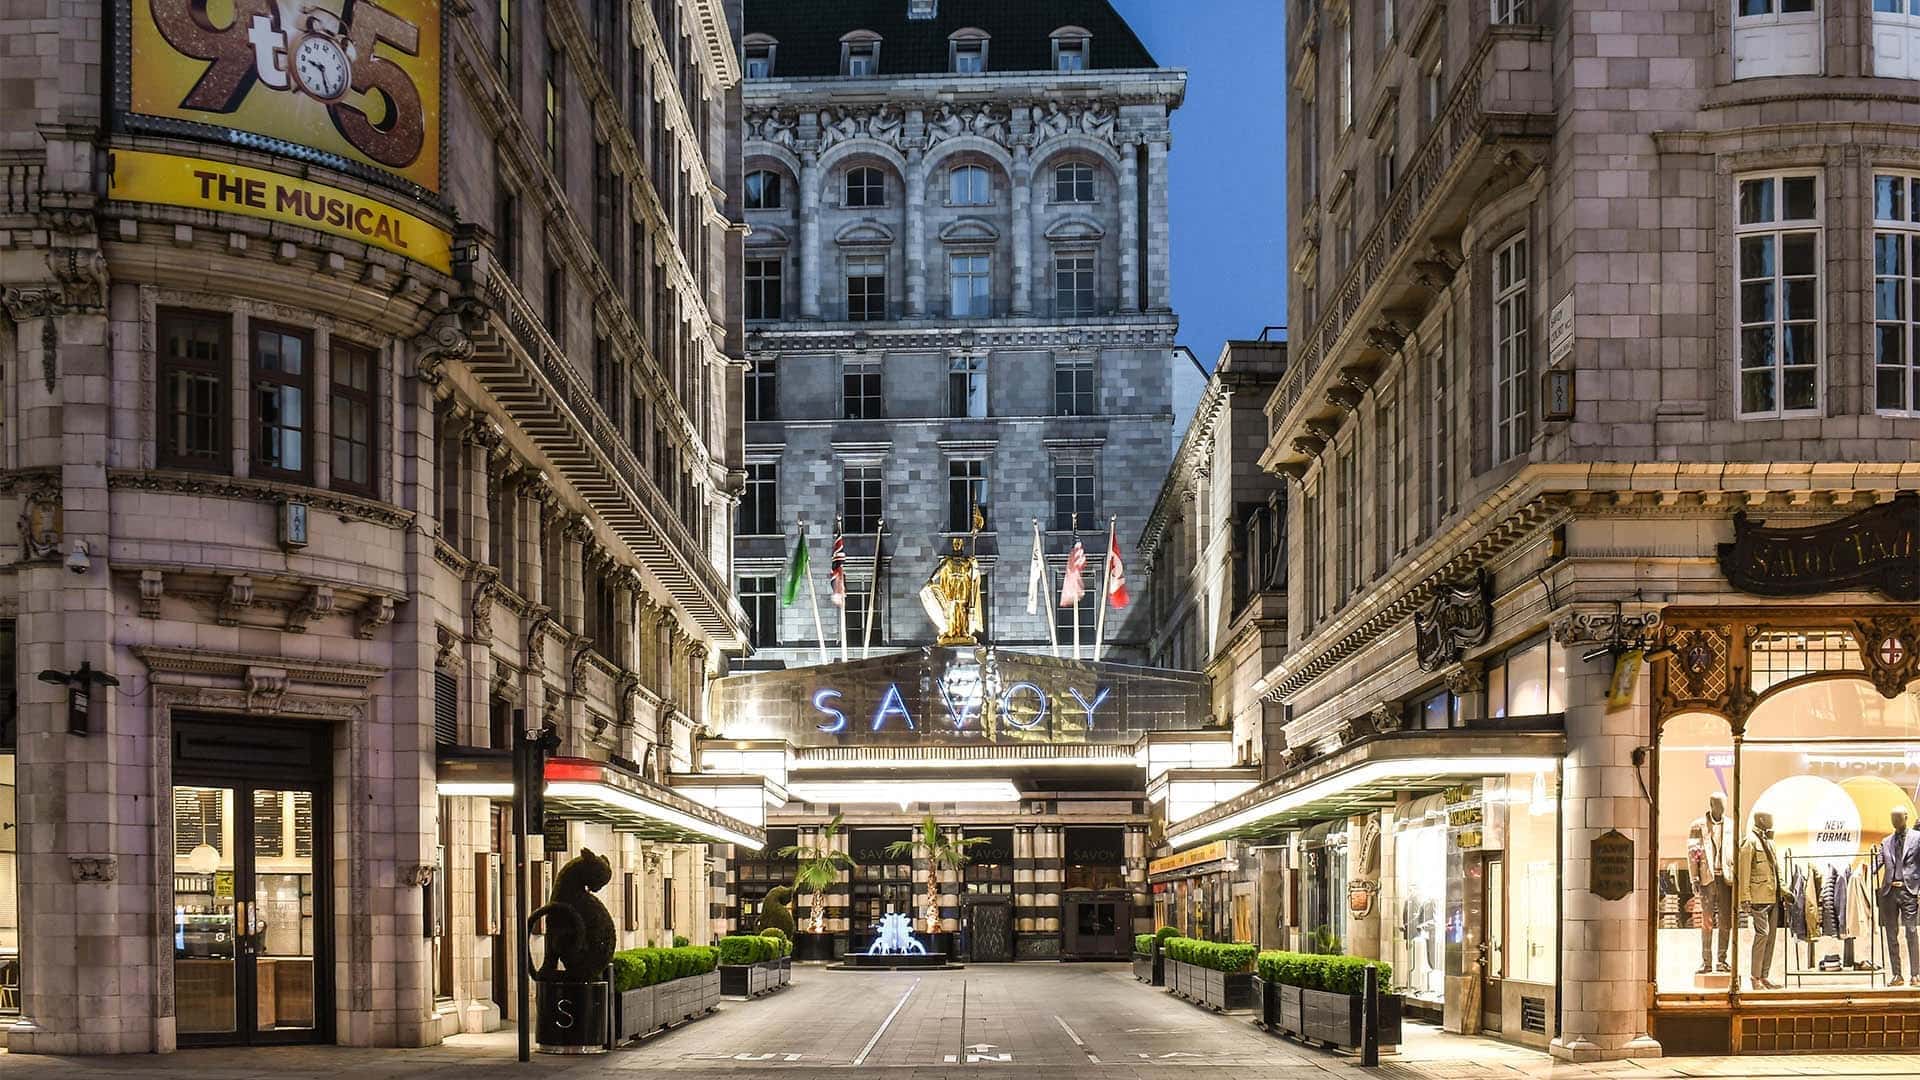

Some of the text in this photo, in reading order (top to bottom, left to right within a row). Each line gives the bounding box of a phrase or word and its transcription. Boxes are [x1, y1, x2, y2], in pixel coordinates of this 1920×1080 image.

[150, 0, 254, 112] 9
[329, 0, 424, 169] 5
[194, 170, 409, 249] THE MUSICAL
[1555, 375, 1564, 411] TAXI
[815, 679, 1110, 732] SAVOY
[1816, 831, 1851, 842] FORMAL
[1824, 820, 1846, 830] NEW
[555, 999, 574, 1029] S
